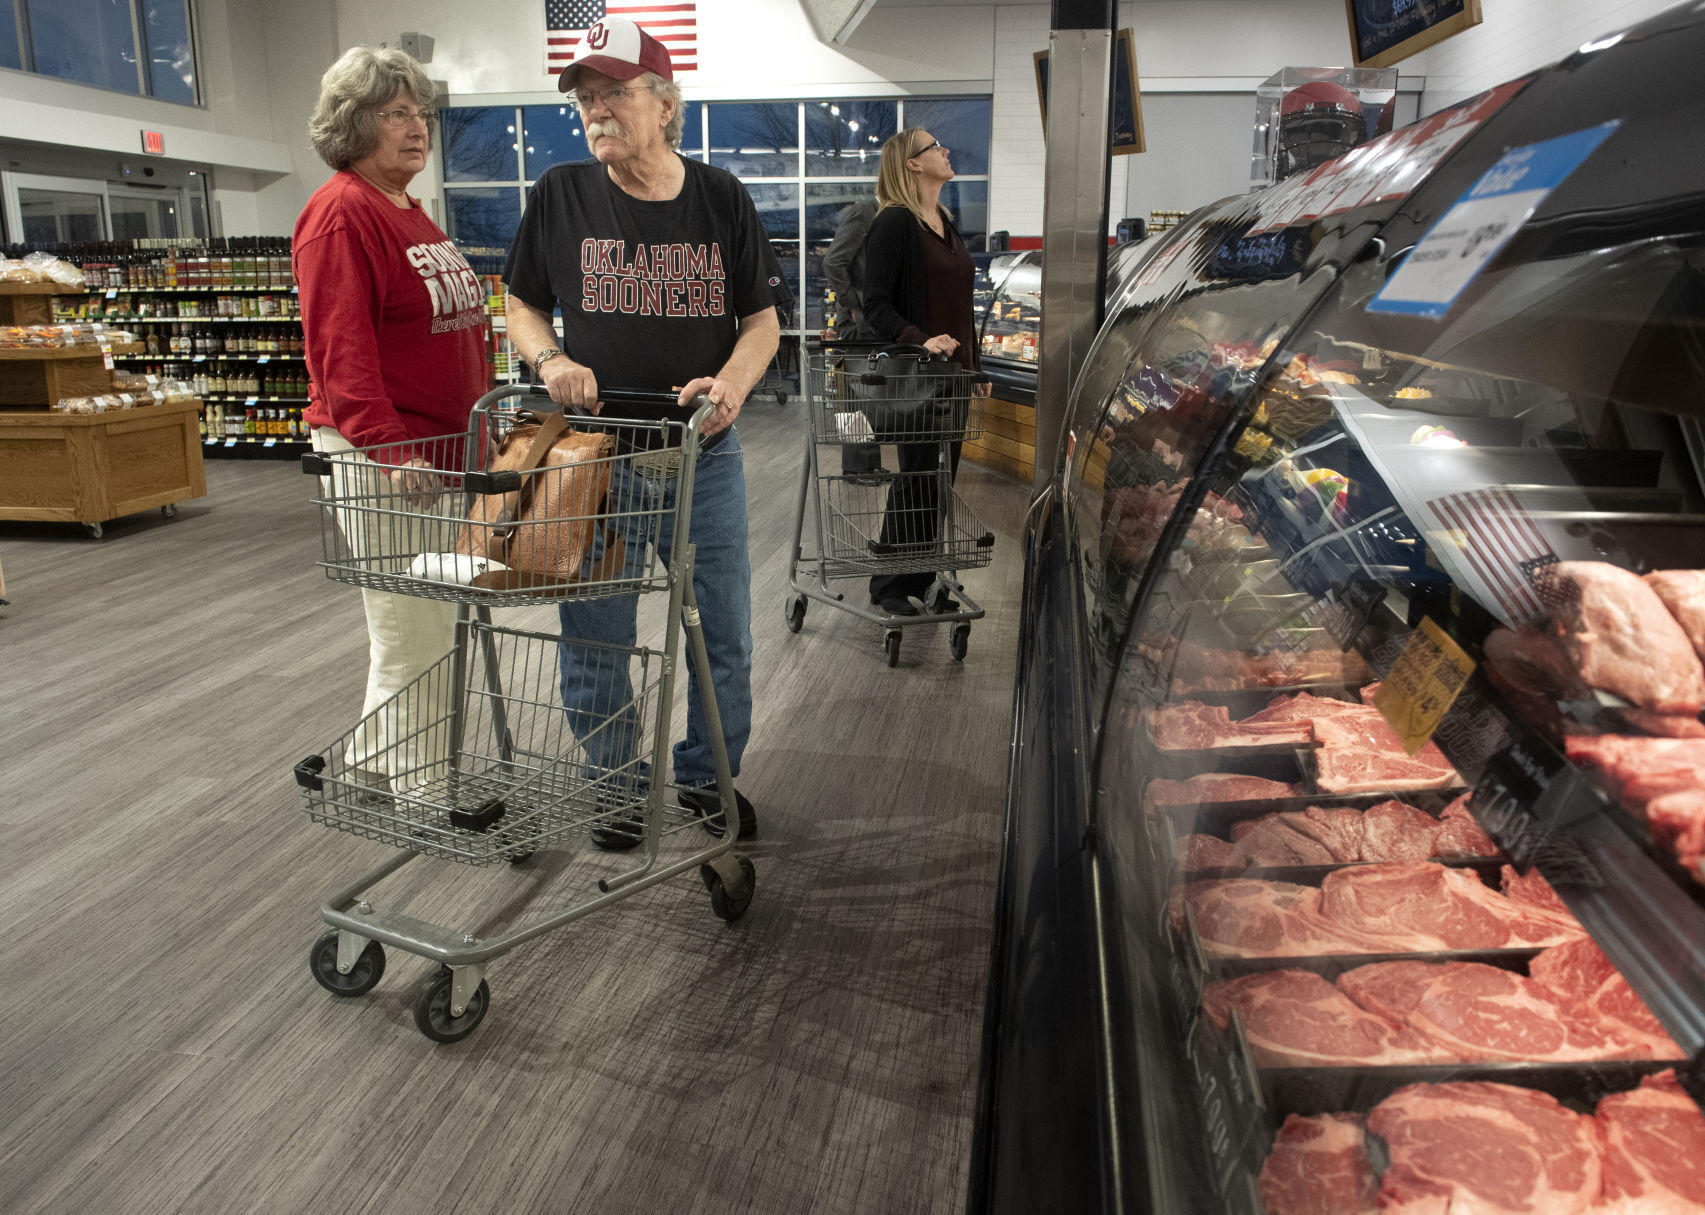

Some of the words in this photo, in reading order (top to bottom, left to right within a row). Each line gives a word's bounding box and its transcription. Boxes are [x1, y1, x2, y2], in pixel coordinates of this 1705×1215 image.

[587, 22, 609, 50] OU
[145, 131, 162, 153] EXIT
[581, 238, 725, 280] OKLAHOMA
[582, 275, 725, 317] SOONERS
